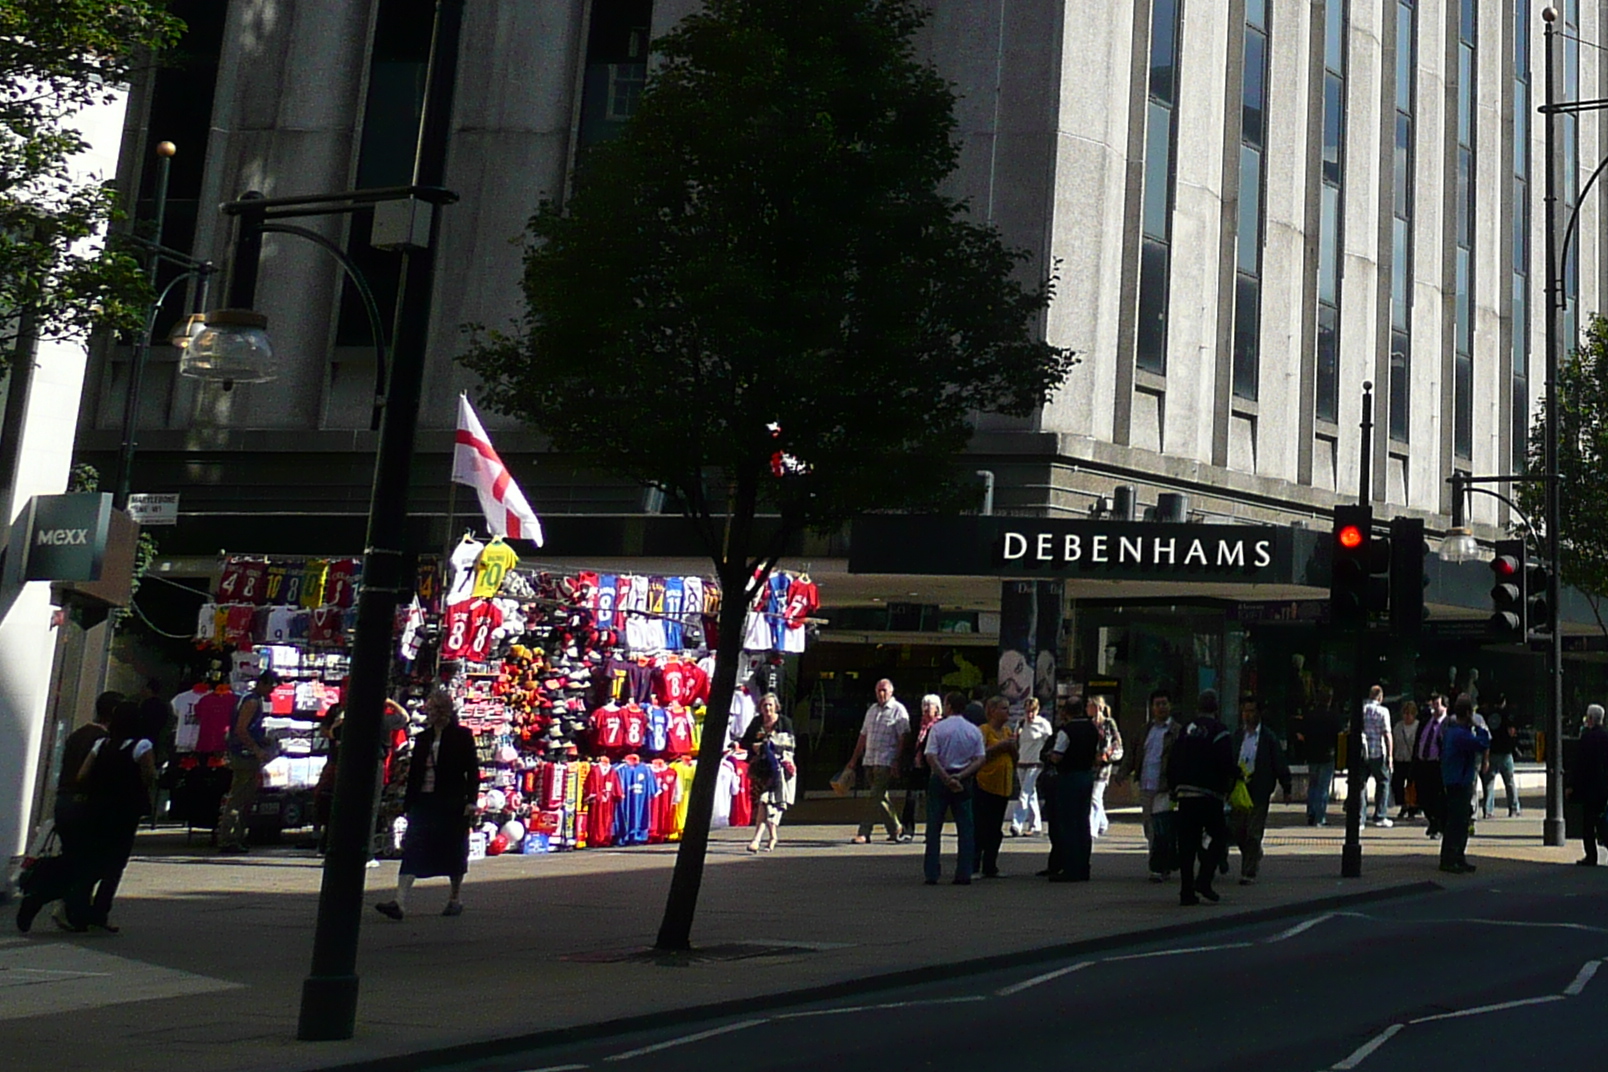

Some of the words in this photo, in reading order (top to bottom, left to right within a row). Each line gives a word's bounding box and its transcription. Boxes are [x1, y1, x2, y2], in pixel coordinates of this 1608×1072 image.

[1003, 532, 1271, 567] DEBENHAMS
[222, 572, 238, 595] 4
[458, 567, 474, 593] 7
[480, 563, 502, 586] 10
[243, 577, 256, 597] 8
[287, 577, 299, 601] 8
[274, 629, 283, 641] 9
[448, 621, 466, 650] 8
[473, 625, 488, 652] 8
[671, 677, 681, 697] 8
[608, 723, 619, 743] 7
[628, 723, 639, 743] 8
[654, 724, 666, 750] 8
[675, 723, 687, 740] 4
